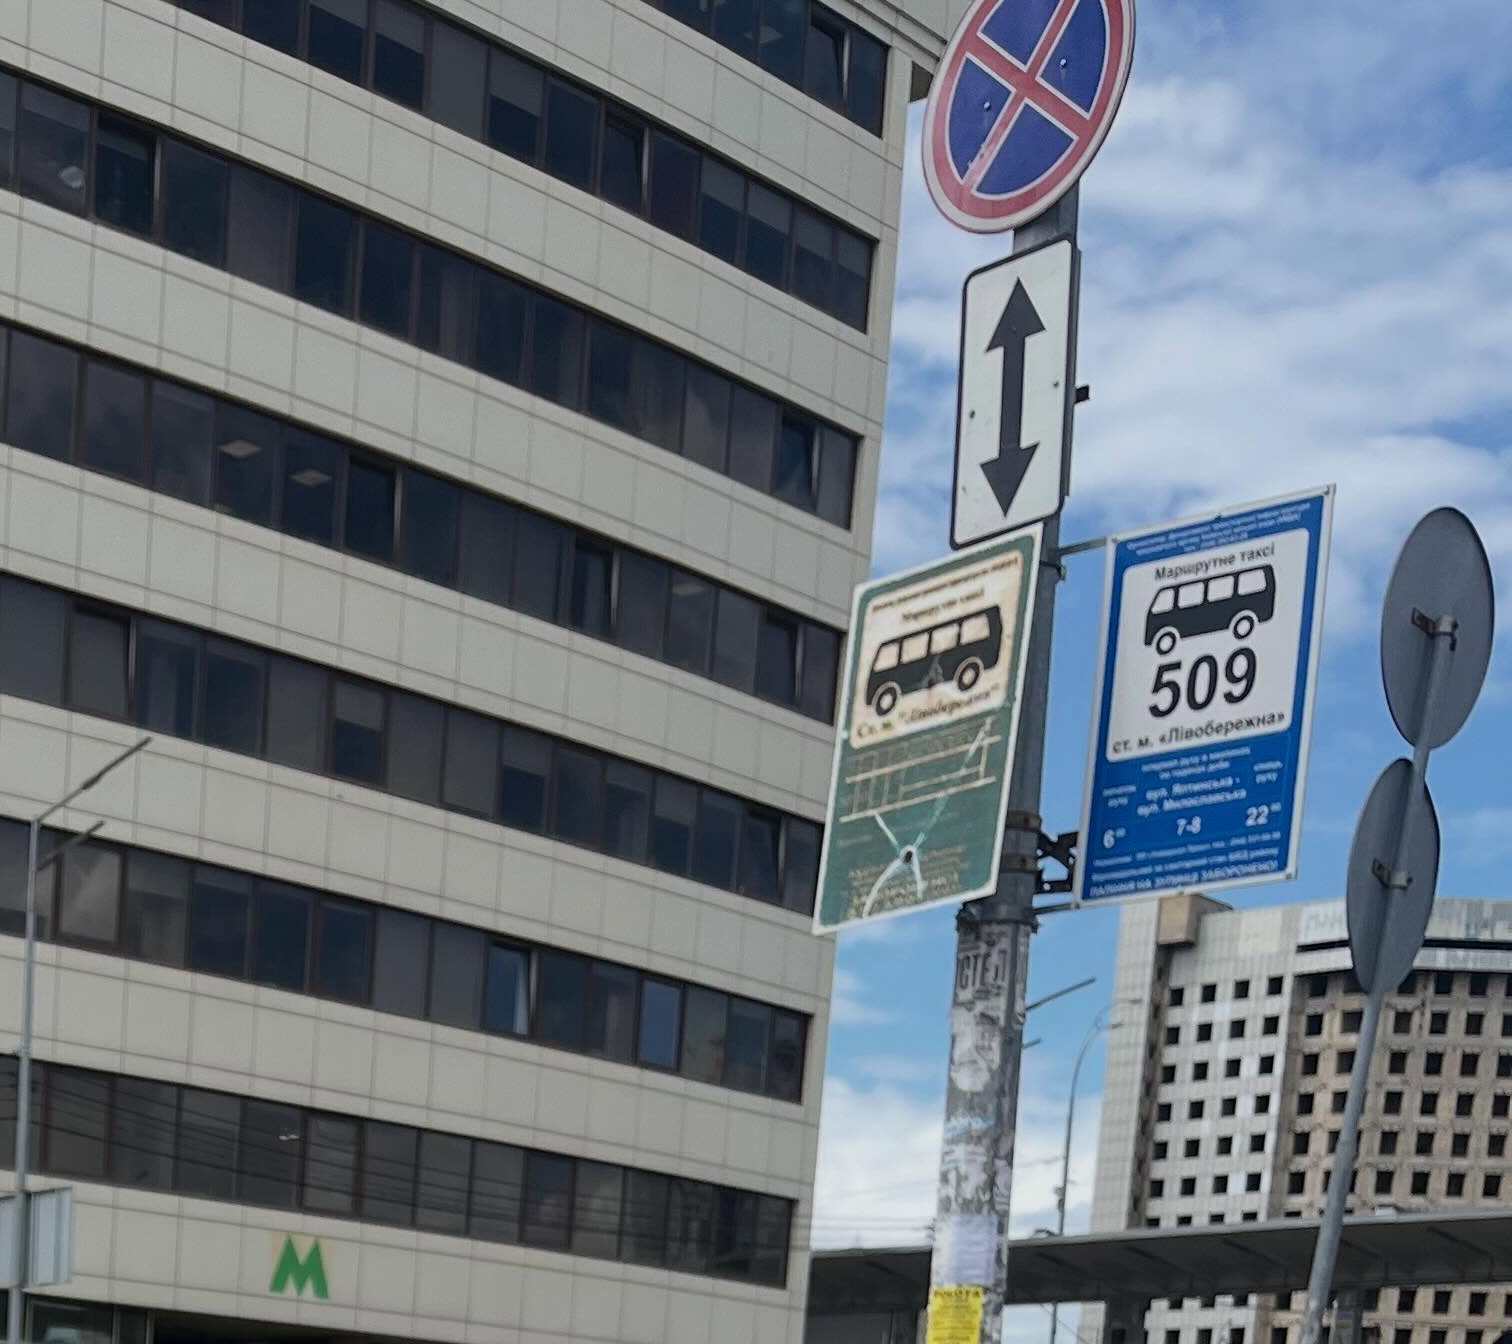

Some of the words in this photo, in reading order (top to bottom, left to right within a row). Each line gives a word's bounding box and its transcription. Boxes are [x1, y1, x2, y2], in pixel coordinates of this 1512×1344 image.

[1154, 554, 1236, 581] Маршрутне
[1240, 542, 1276, 564] таксі
[1149, 647, 1257, 718] 509
[1113, 736, 1132, 755] ст.
[1139, 735, 1154, 750] м.
[1160, 711, 1285, 745] «Лівобережна»
